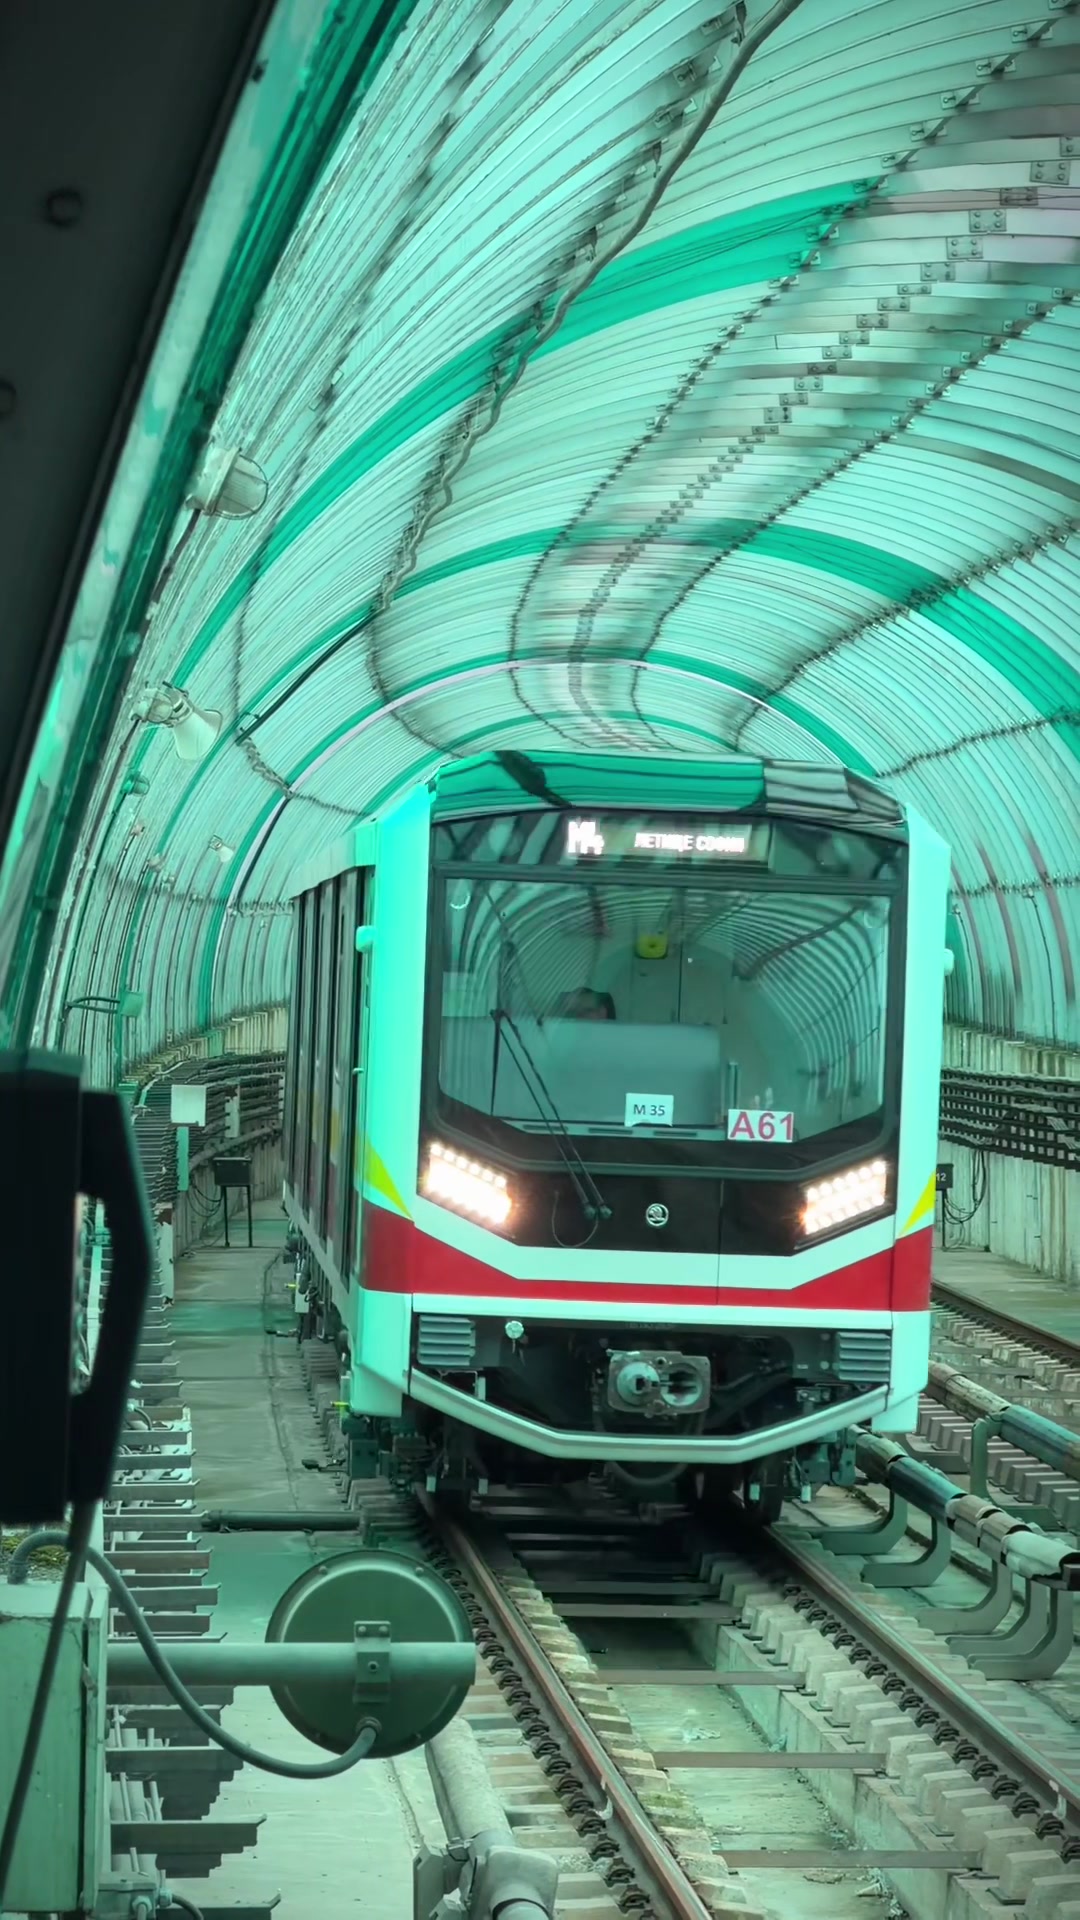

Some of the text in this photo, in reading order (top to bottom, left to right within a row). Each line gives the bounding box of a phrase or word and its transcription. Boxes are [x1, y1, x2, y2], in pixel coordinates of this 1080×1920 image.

[633, 1104, 665, 1116] M 35
[730, 1111, 792, 1141] A61
